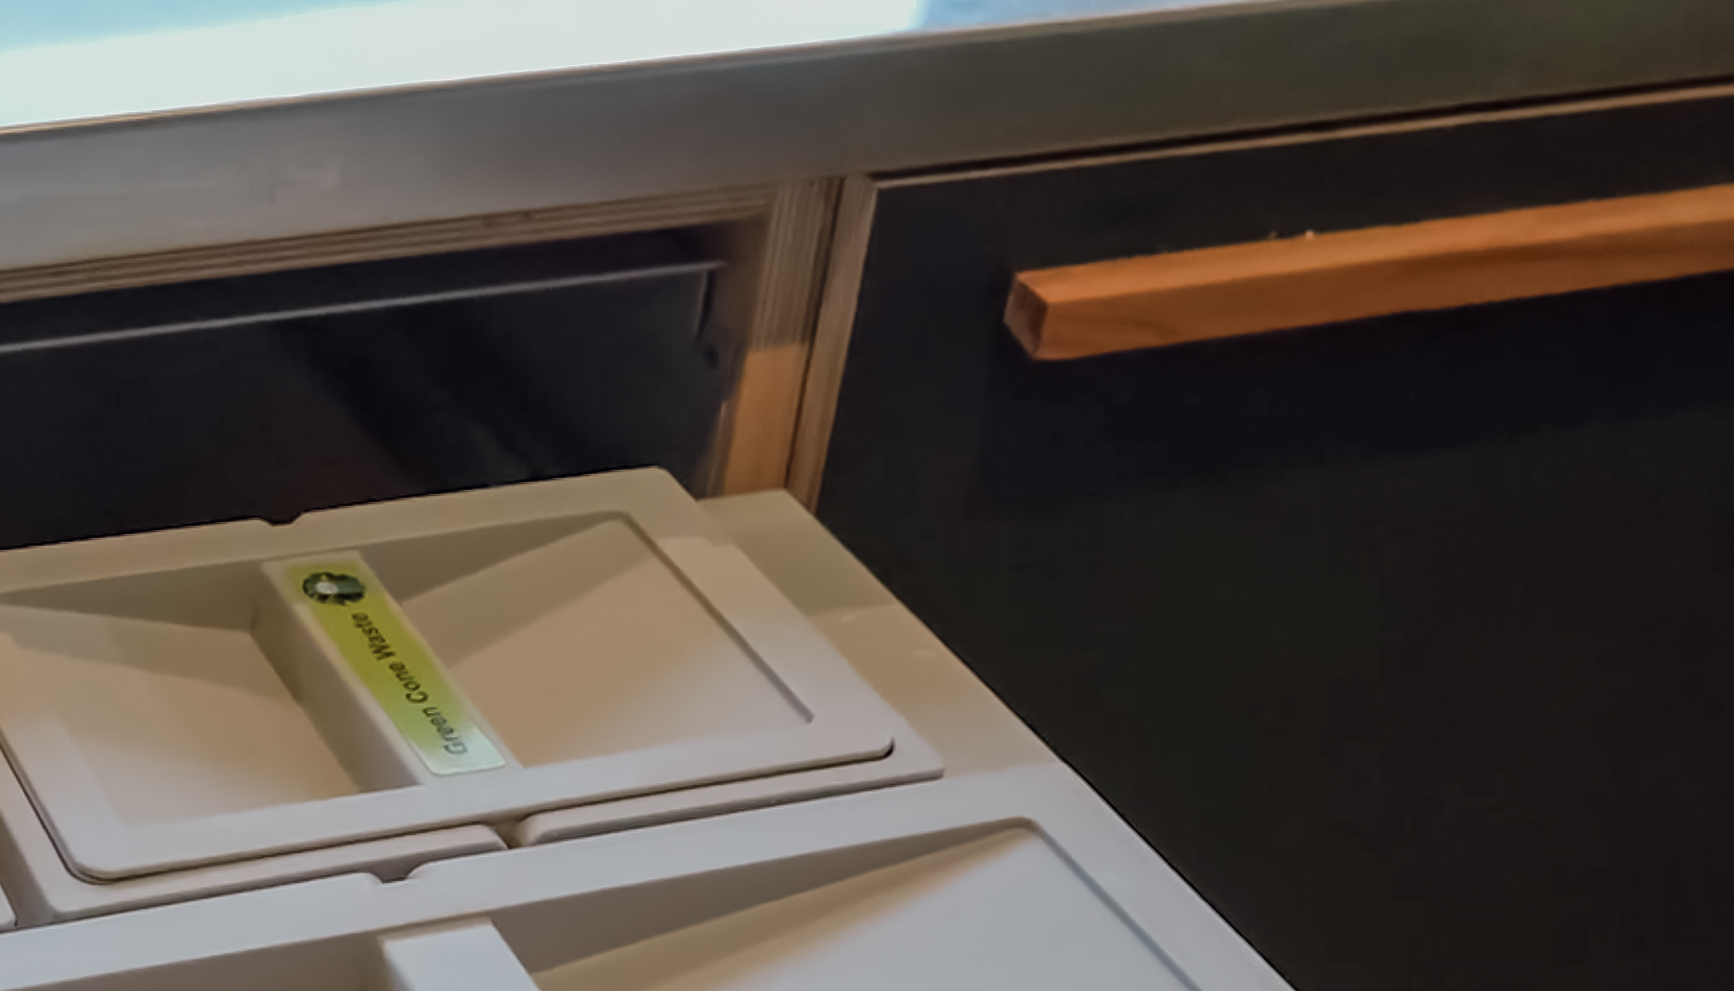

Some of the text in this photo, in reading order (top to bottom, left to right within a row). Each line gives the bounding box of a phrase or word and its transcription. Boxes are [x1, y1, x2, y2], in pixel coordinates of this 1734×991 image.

[351, 612, 468, 756] Green Cone Waste
